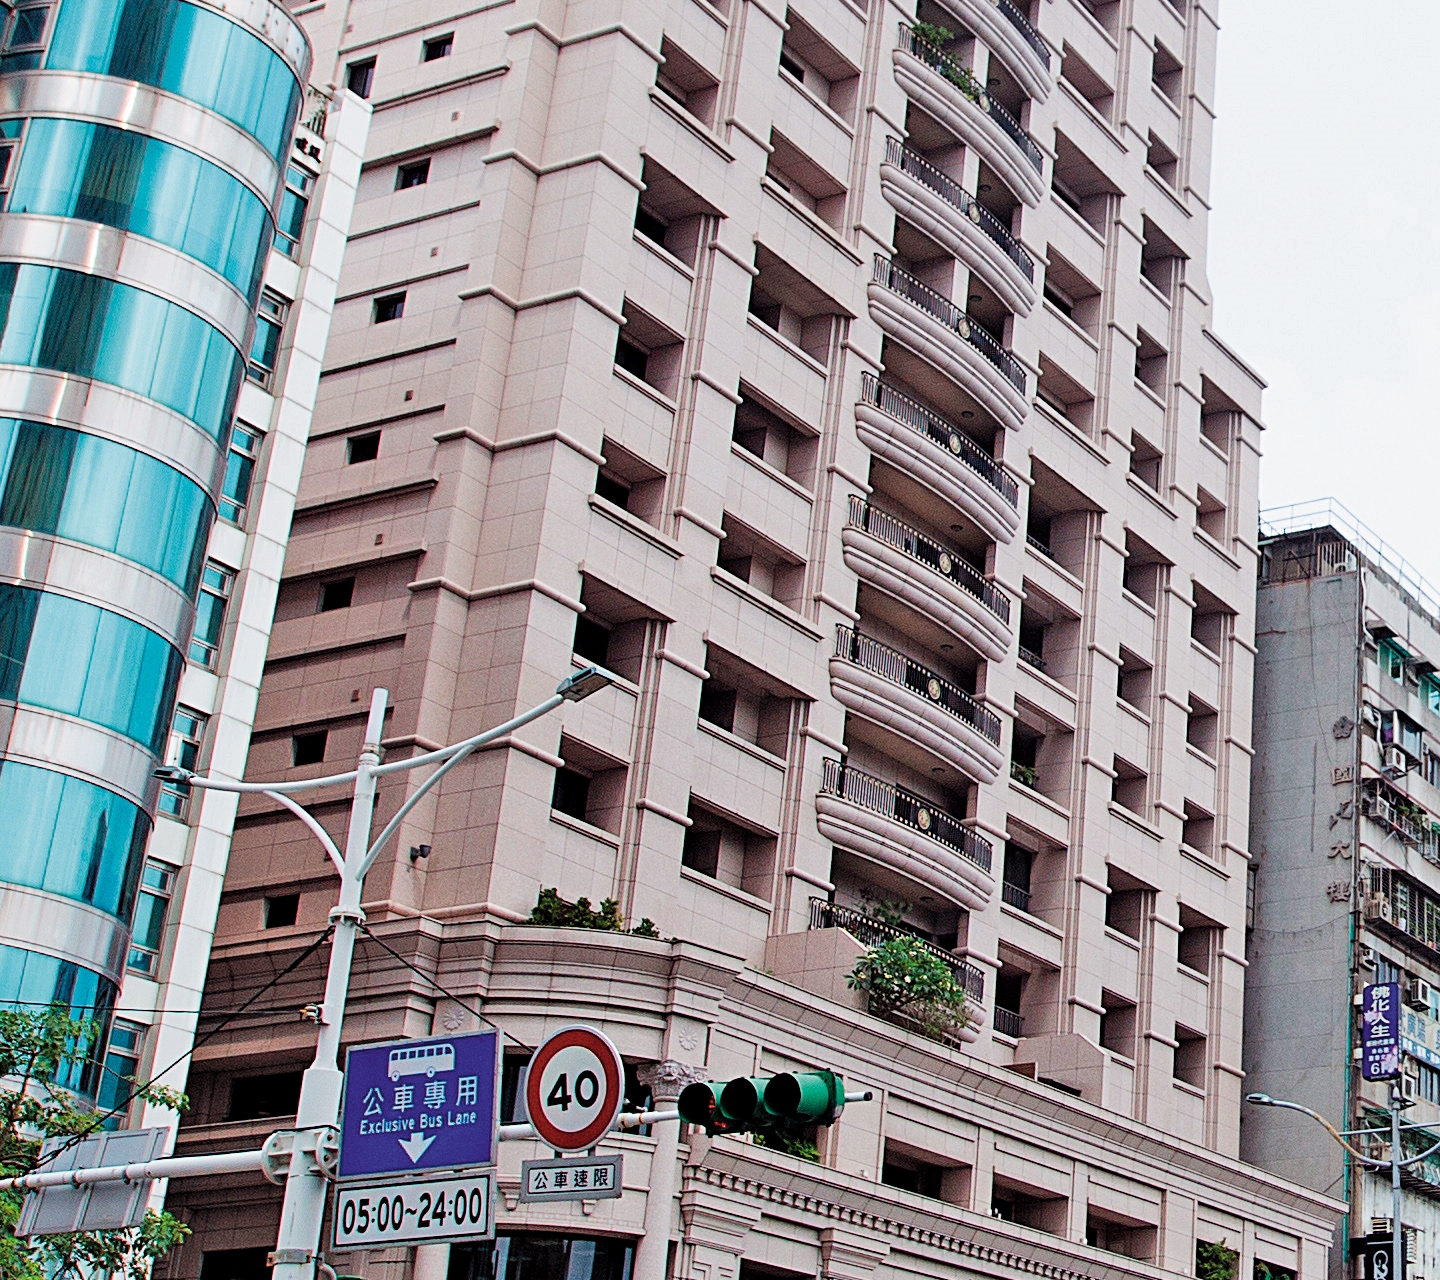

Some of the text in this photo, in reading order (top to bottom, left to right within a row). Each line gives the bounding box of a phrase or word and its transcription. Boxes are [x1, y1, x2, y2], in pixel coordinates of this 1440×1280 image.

[1370, 986, 1391, 1039] 佛化人生
[362, 1074, 479, 1117] 公車專用
[547, 1069, 600, 1112] 40
[359, 1109, 478, 1136] Exclusive Bus Lane
[534, 1166, 611, 1191] 公車速限
[342, 1186, 483, 1235] 05:00~24:00
